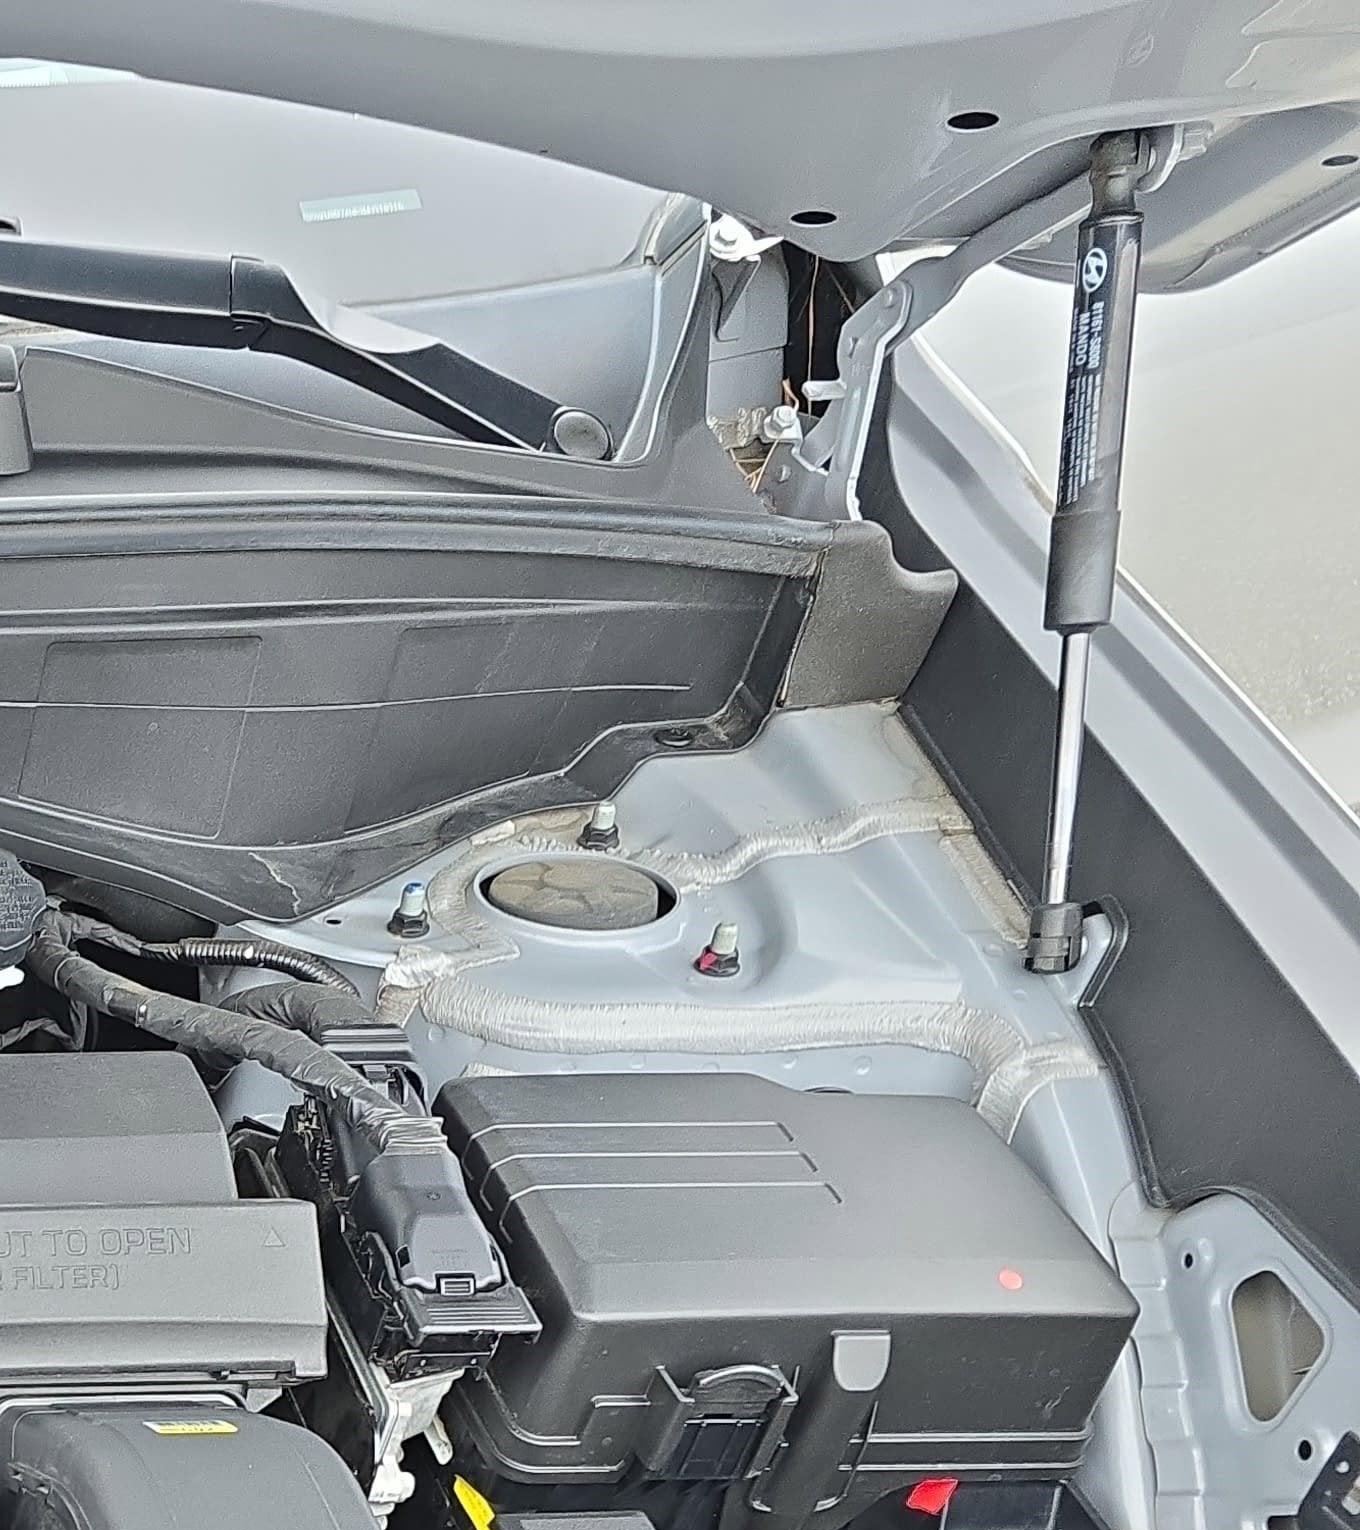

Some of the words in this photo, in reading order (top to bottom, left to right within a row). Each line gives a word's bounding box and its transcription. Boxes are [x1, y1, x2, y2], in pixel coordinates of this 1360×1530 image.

[1075, 312, 1091, 366] MANDO
[42, 1229, 89, 1258] TO
[100, 1227, 192, 1256] OPEN
[12, 1264, 120, 1291] FILTER)
